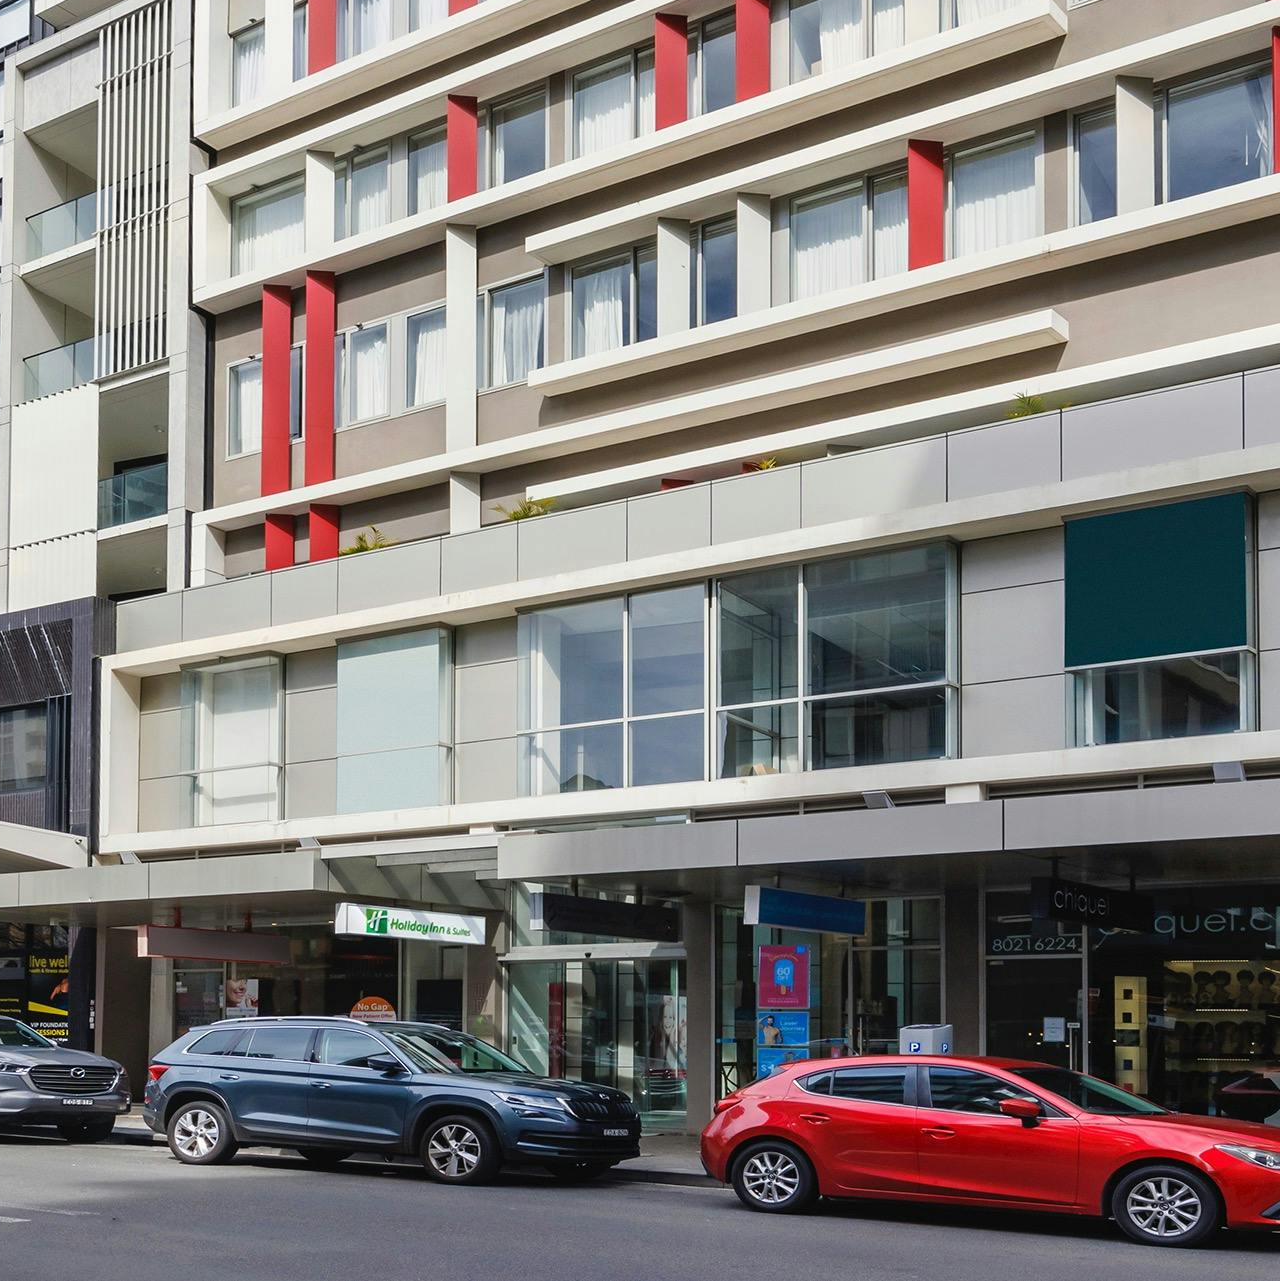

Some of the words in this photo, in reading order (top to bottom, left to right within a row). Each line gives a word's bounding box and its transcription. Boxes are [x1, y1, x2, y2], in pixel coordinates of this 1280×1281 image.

[452, 927, 471, 937] Suites
[992, 937, 1077, 951] 80216224
[29, 955, 47, 968] live
[48, 954, 69, 968] wel
[357, 1003, 370, 1011] No
[370, 1002, 388, 1012] Gap
[911, 1042, 919, 1052] P
[942, 1043, 948, 1052] P
